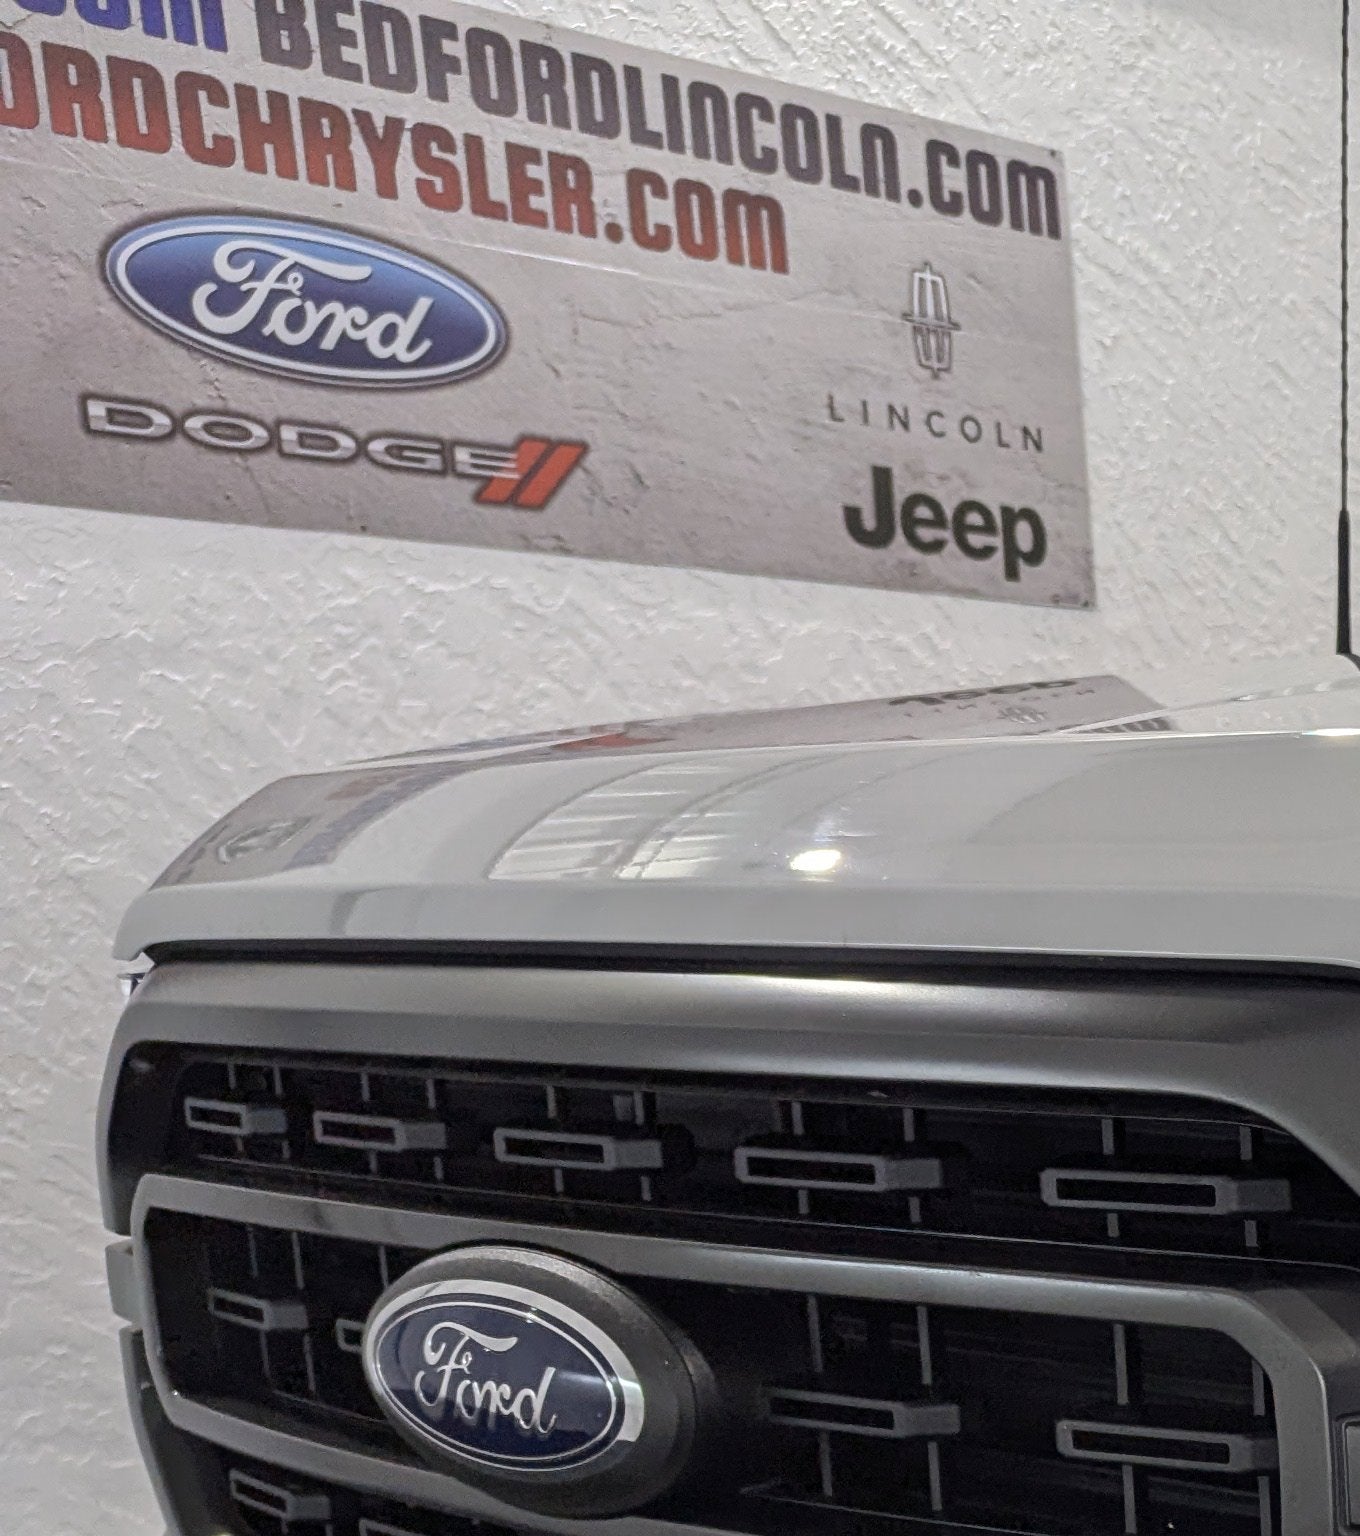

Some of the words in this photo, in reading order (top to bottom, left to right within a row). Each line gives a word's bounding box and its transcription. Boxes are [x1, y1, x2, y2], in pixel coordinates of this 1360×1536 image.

[191, 239, 434, 364] Ford
[84, 398, 521, 480] DODGE
[827, 393, 1044, 453] LINCOLN
[842, 465, 1047, 582] Jeep
[413, 1321, 558, 1435] Ford
